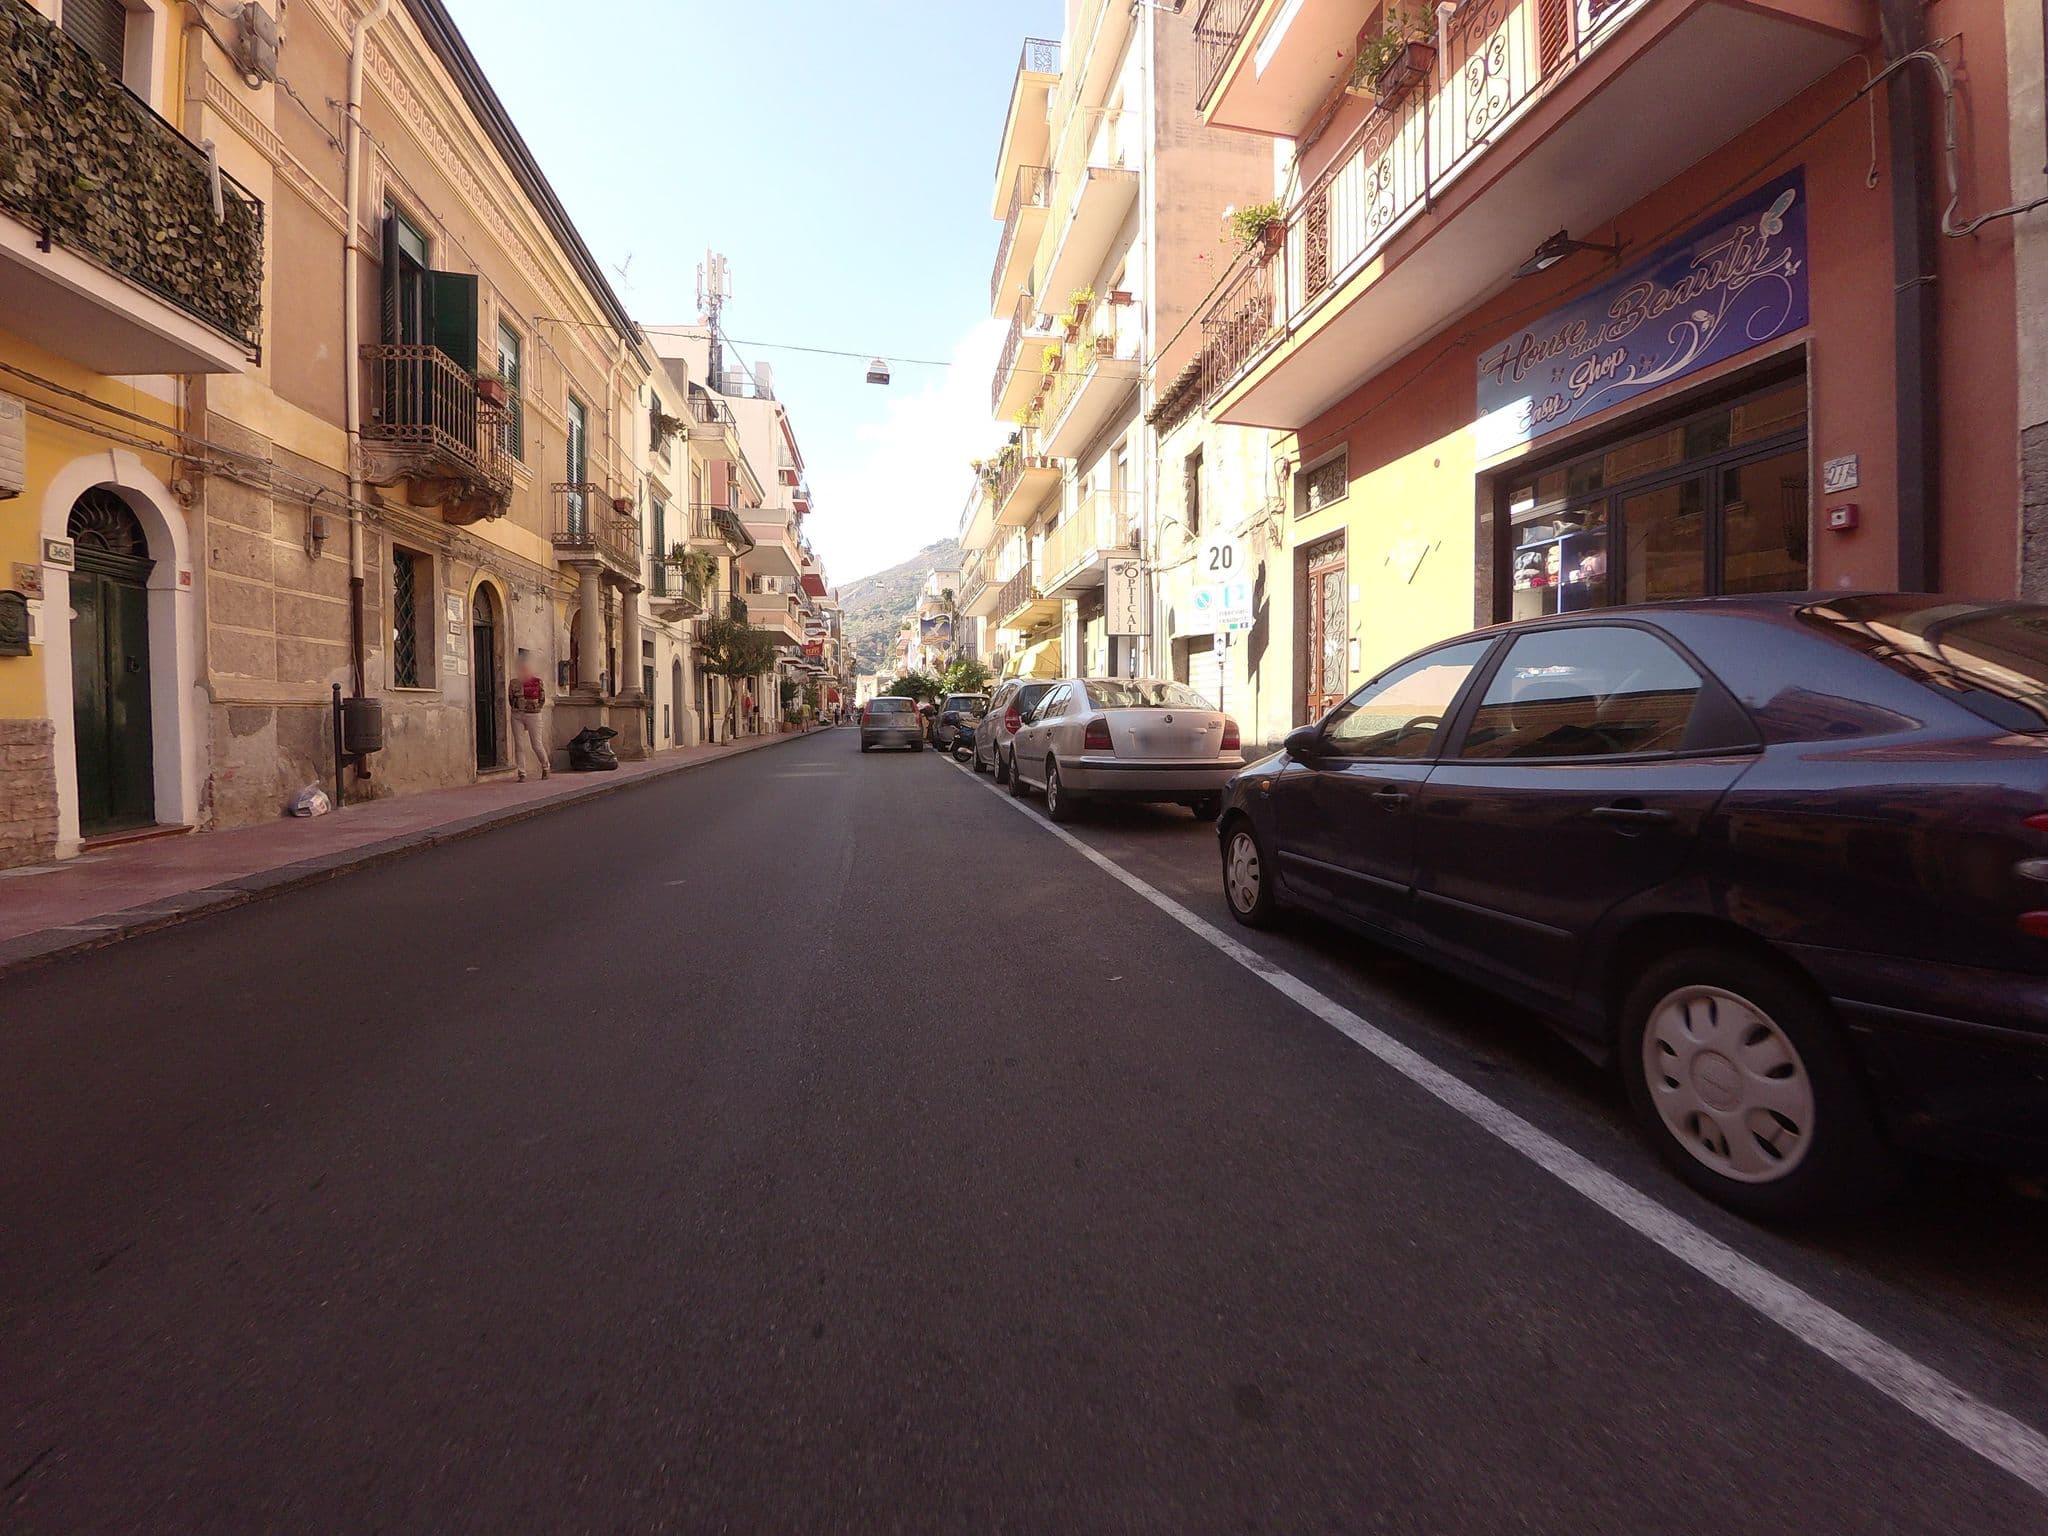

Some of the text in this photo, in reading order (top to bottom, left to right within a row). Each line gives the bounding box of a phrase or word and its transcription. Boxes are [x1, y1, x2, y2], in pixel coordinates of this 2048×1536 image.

[1482, 225, 1792, 385] House and Beauty
[1517, 347, 1626, 434] Easy Shop
[1209, 545, 1233, 571] 20
[1124, 567, 1139, 633] OPTICAL
